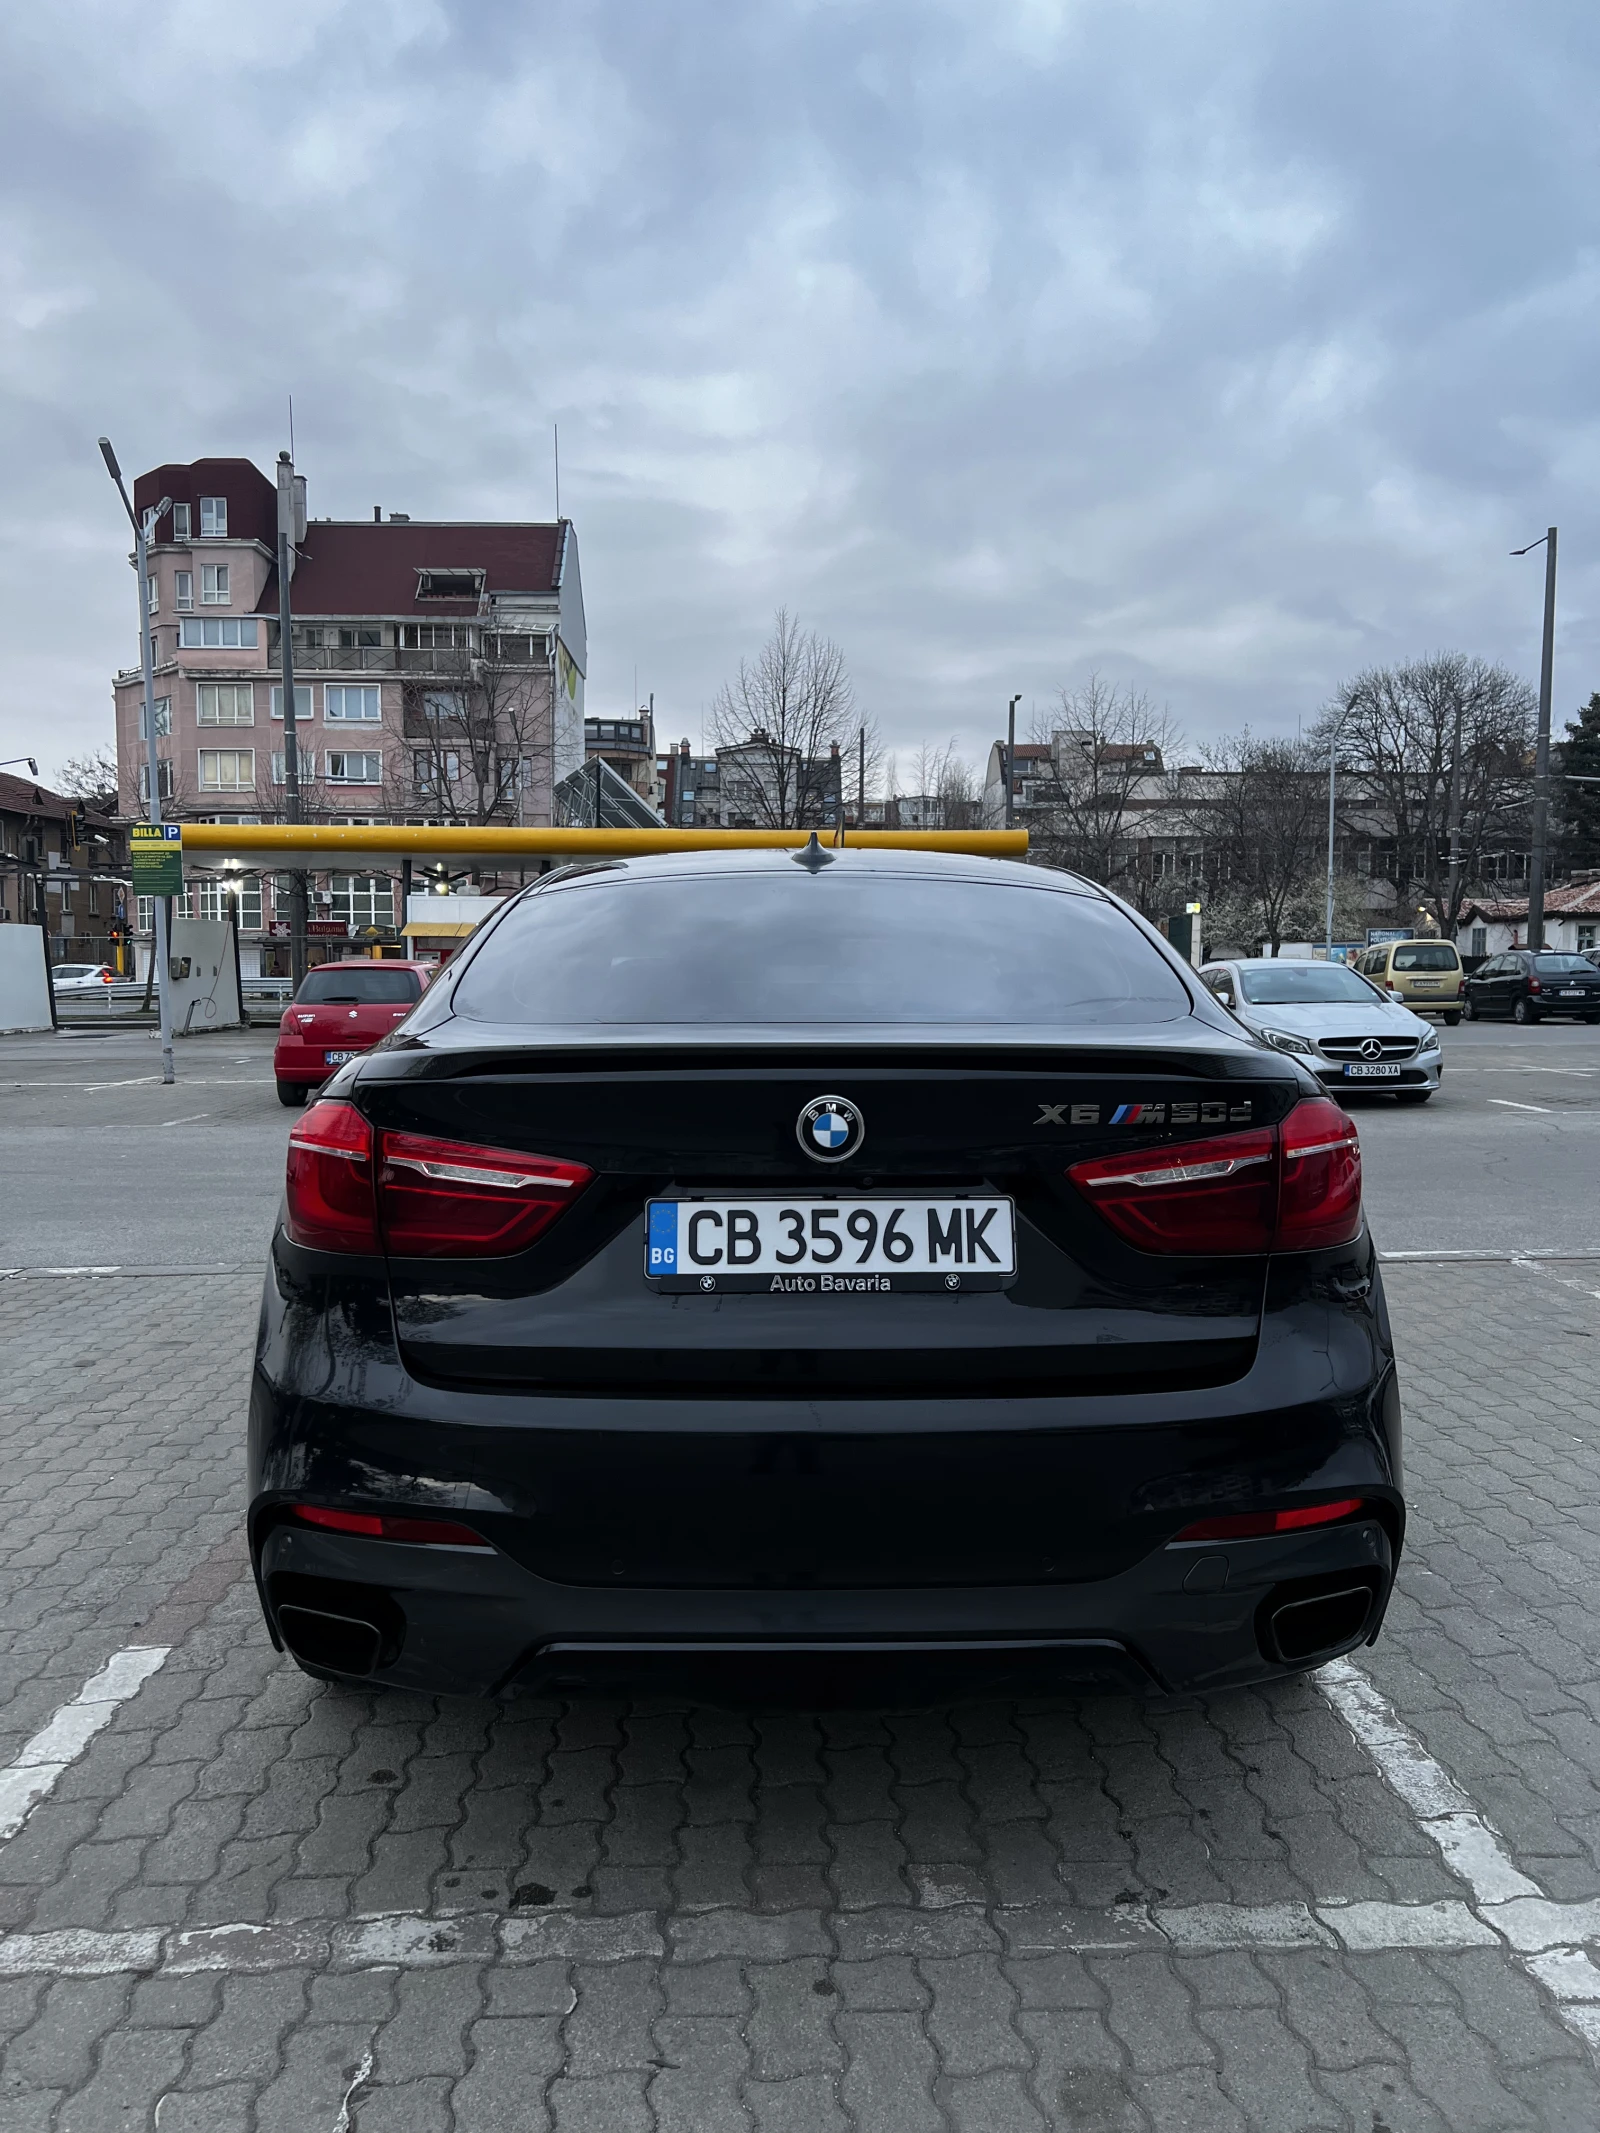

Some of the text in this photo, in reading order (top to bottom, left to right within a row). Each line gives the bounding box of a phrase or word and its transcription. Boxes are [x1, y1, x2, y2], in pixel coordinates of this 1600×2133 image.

[132, 827, 162, 838] BILLA
[167, 826, 179, 839] P
[1350, 1065, 1399, 1075] CB 3280 XA
[807, 1103, 855, 1122] BMW
[1033, 1104, 1100, 1125] X6
[688, 1207, 1002, 1266] CB 3596 MK
[651, 1247, 675, 1264] BG
[769, 1274, 891, 1292] Auto Bavaria
